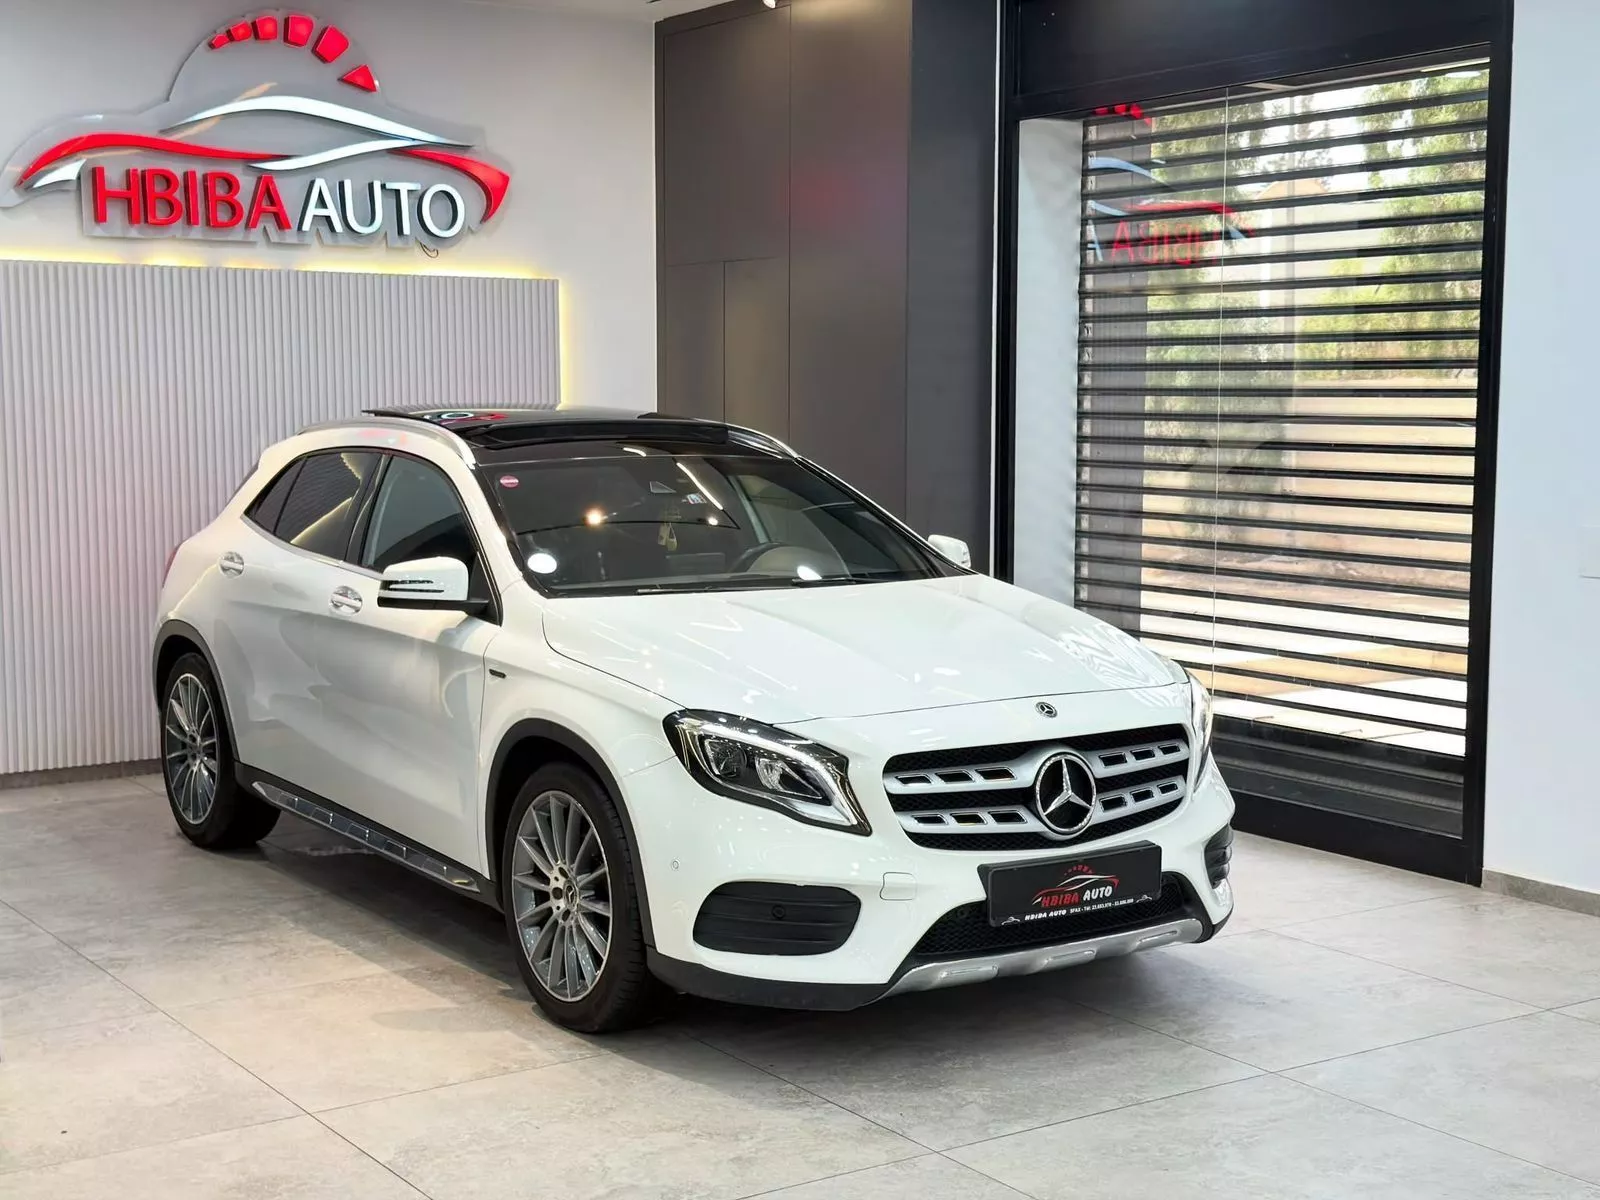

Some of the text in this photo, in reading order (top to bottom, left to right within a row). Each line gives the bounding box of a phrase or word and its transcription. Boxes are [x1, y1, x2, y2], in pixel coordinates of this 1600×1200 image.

[92, 166, 465, 238] HBIBA AUTO
[1041, 885, 1113, 907] HBIBA AUTO
[1024, 912, 1047, 920] HBIBA
[1048, 909, 1067, 918] AUTO
